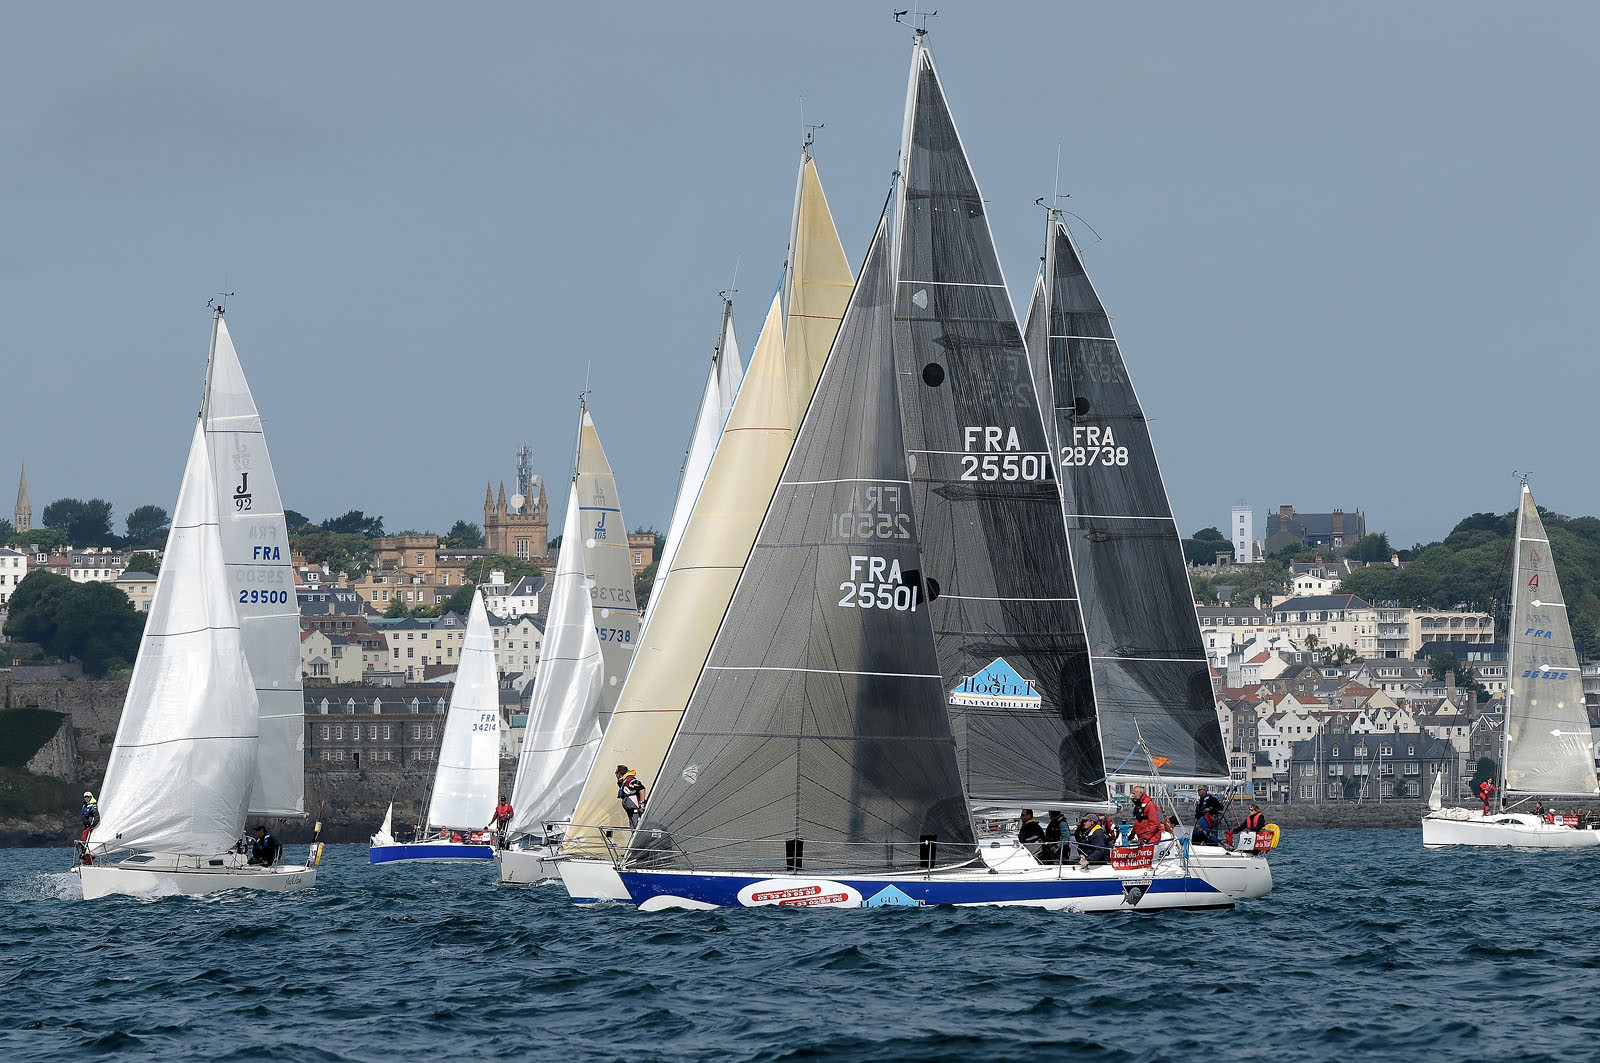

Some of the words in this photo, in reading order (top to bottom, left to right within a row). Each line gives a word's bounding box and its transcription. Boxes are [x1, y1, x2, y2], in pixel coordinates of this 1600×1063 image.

[964, 427, 1021, 452] FRA
[1073, 426, 1115, 446] FRA
[1061, 446, 1129, 467] 28738
[960, 455, 1046, 481] 25501
[236, 472, 249, 494] J
[235, 498, 252, 511] 92
[597, 512, 607, 528] J
[594, 532, 607, 540] 105
[253, 546, 281, 560] FRA
[850, 555, 903, 584] FRA
[239, 589, 288, 604] 29500
[838, 581, 918, 612] 25501
[595, 627, 631, 642] 5738
[1524, 628, 1552, 640] FRA
[480, 714, 496, 723] FRA
[472, 723, 496, 732] 34214
[1243, 837, 1252, 845] 75
[1113, 850, 1128, 859] Tour
